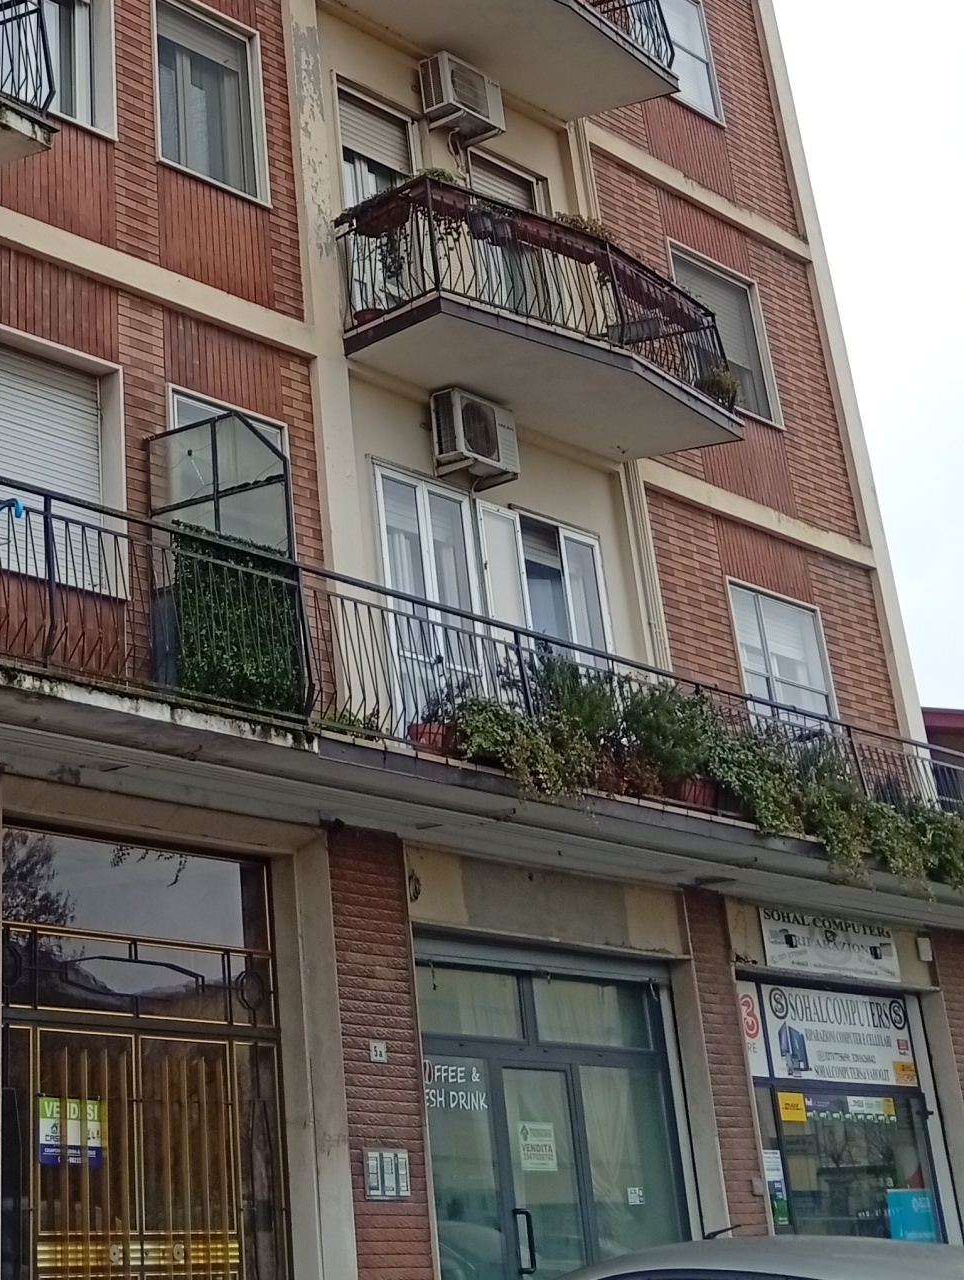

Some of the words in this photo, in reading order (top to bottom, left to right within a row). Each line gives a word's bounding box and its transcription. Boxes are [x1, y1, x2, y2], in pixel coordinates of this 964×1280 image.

[763, 909, 810, 927] SOHAL
[471, 1066, 480, 1082] &
[449, 1090, 488, 1111] DRINK
[44, 1101, 98, 1120] VEDSI
[521, 1143, 553, 1153] VENDITA
